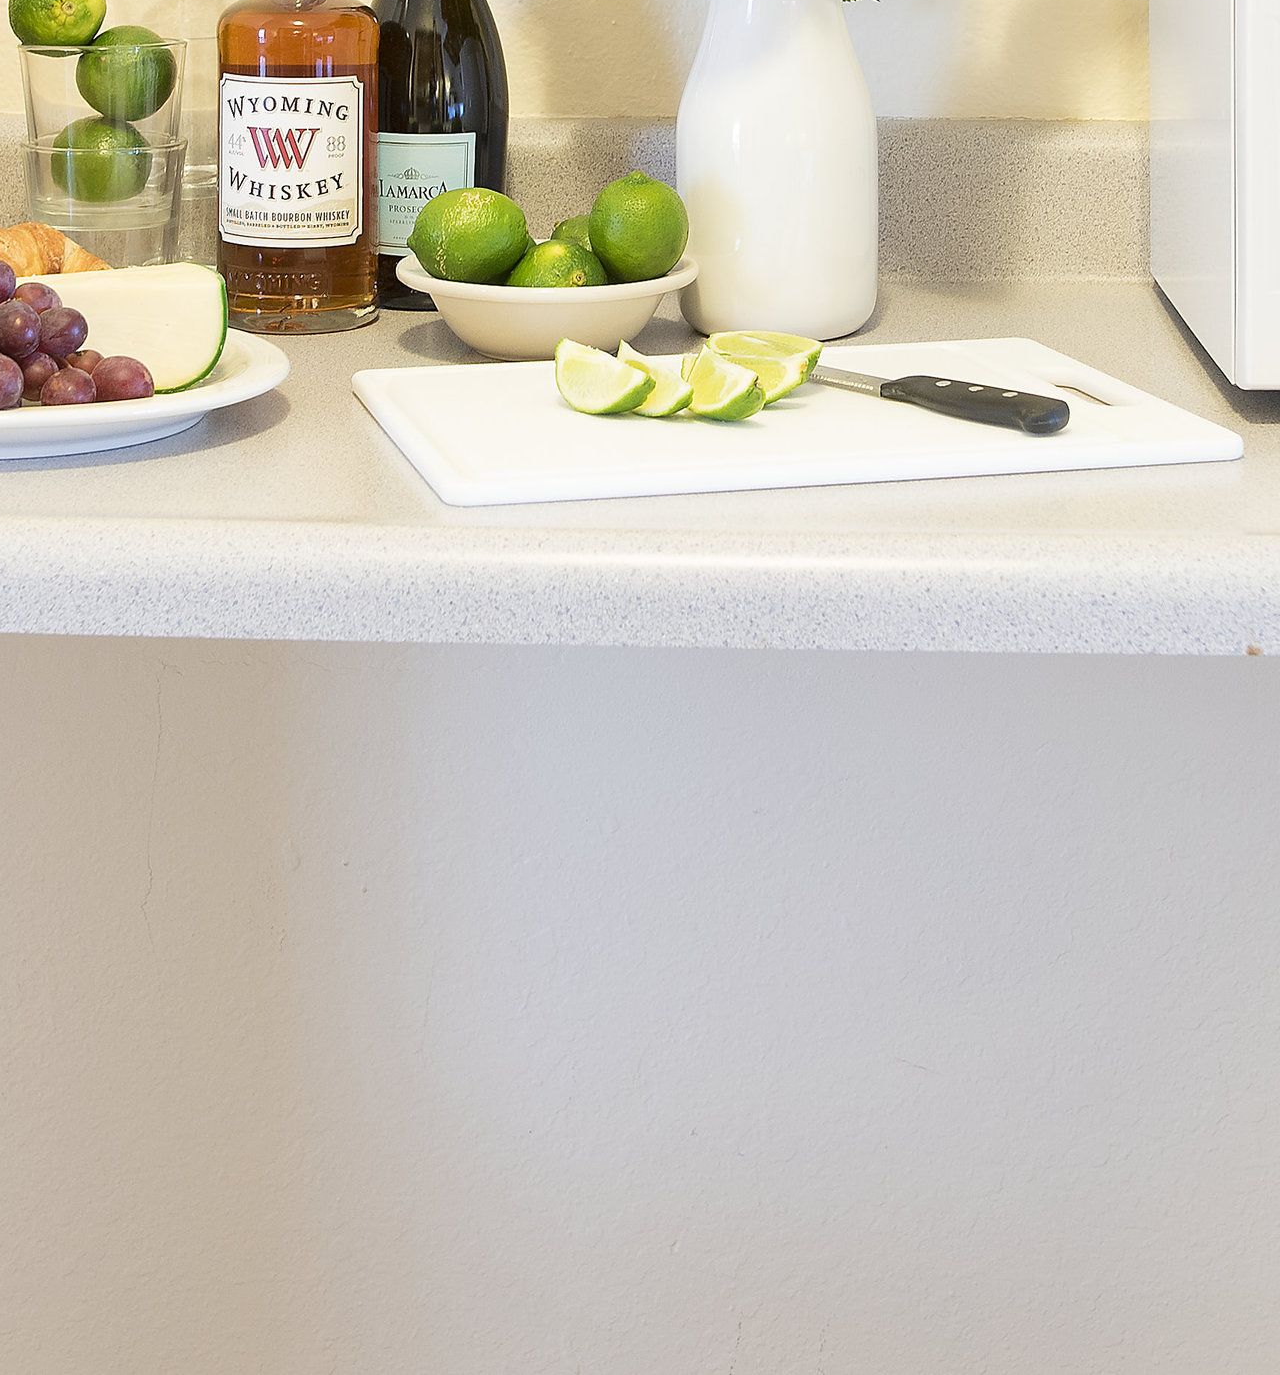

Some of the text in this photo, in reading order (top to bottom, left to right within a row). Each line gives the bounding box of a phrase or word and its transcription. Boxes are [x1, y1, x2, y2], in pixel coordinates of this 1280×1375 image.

[227, 95, 350, 122] WYOMING
[326, 135, 346, 152] 88
[229, 166, 343, 201] WHISKEY
[226, 207, 350, 222] SMALL BATCH BOURBON WHISKEY
